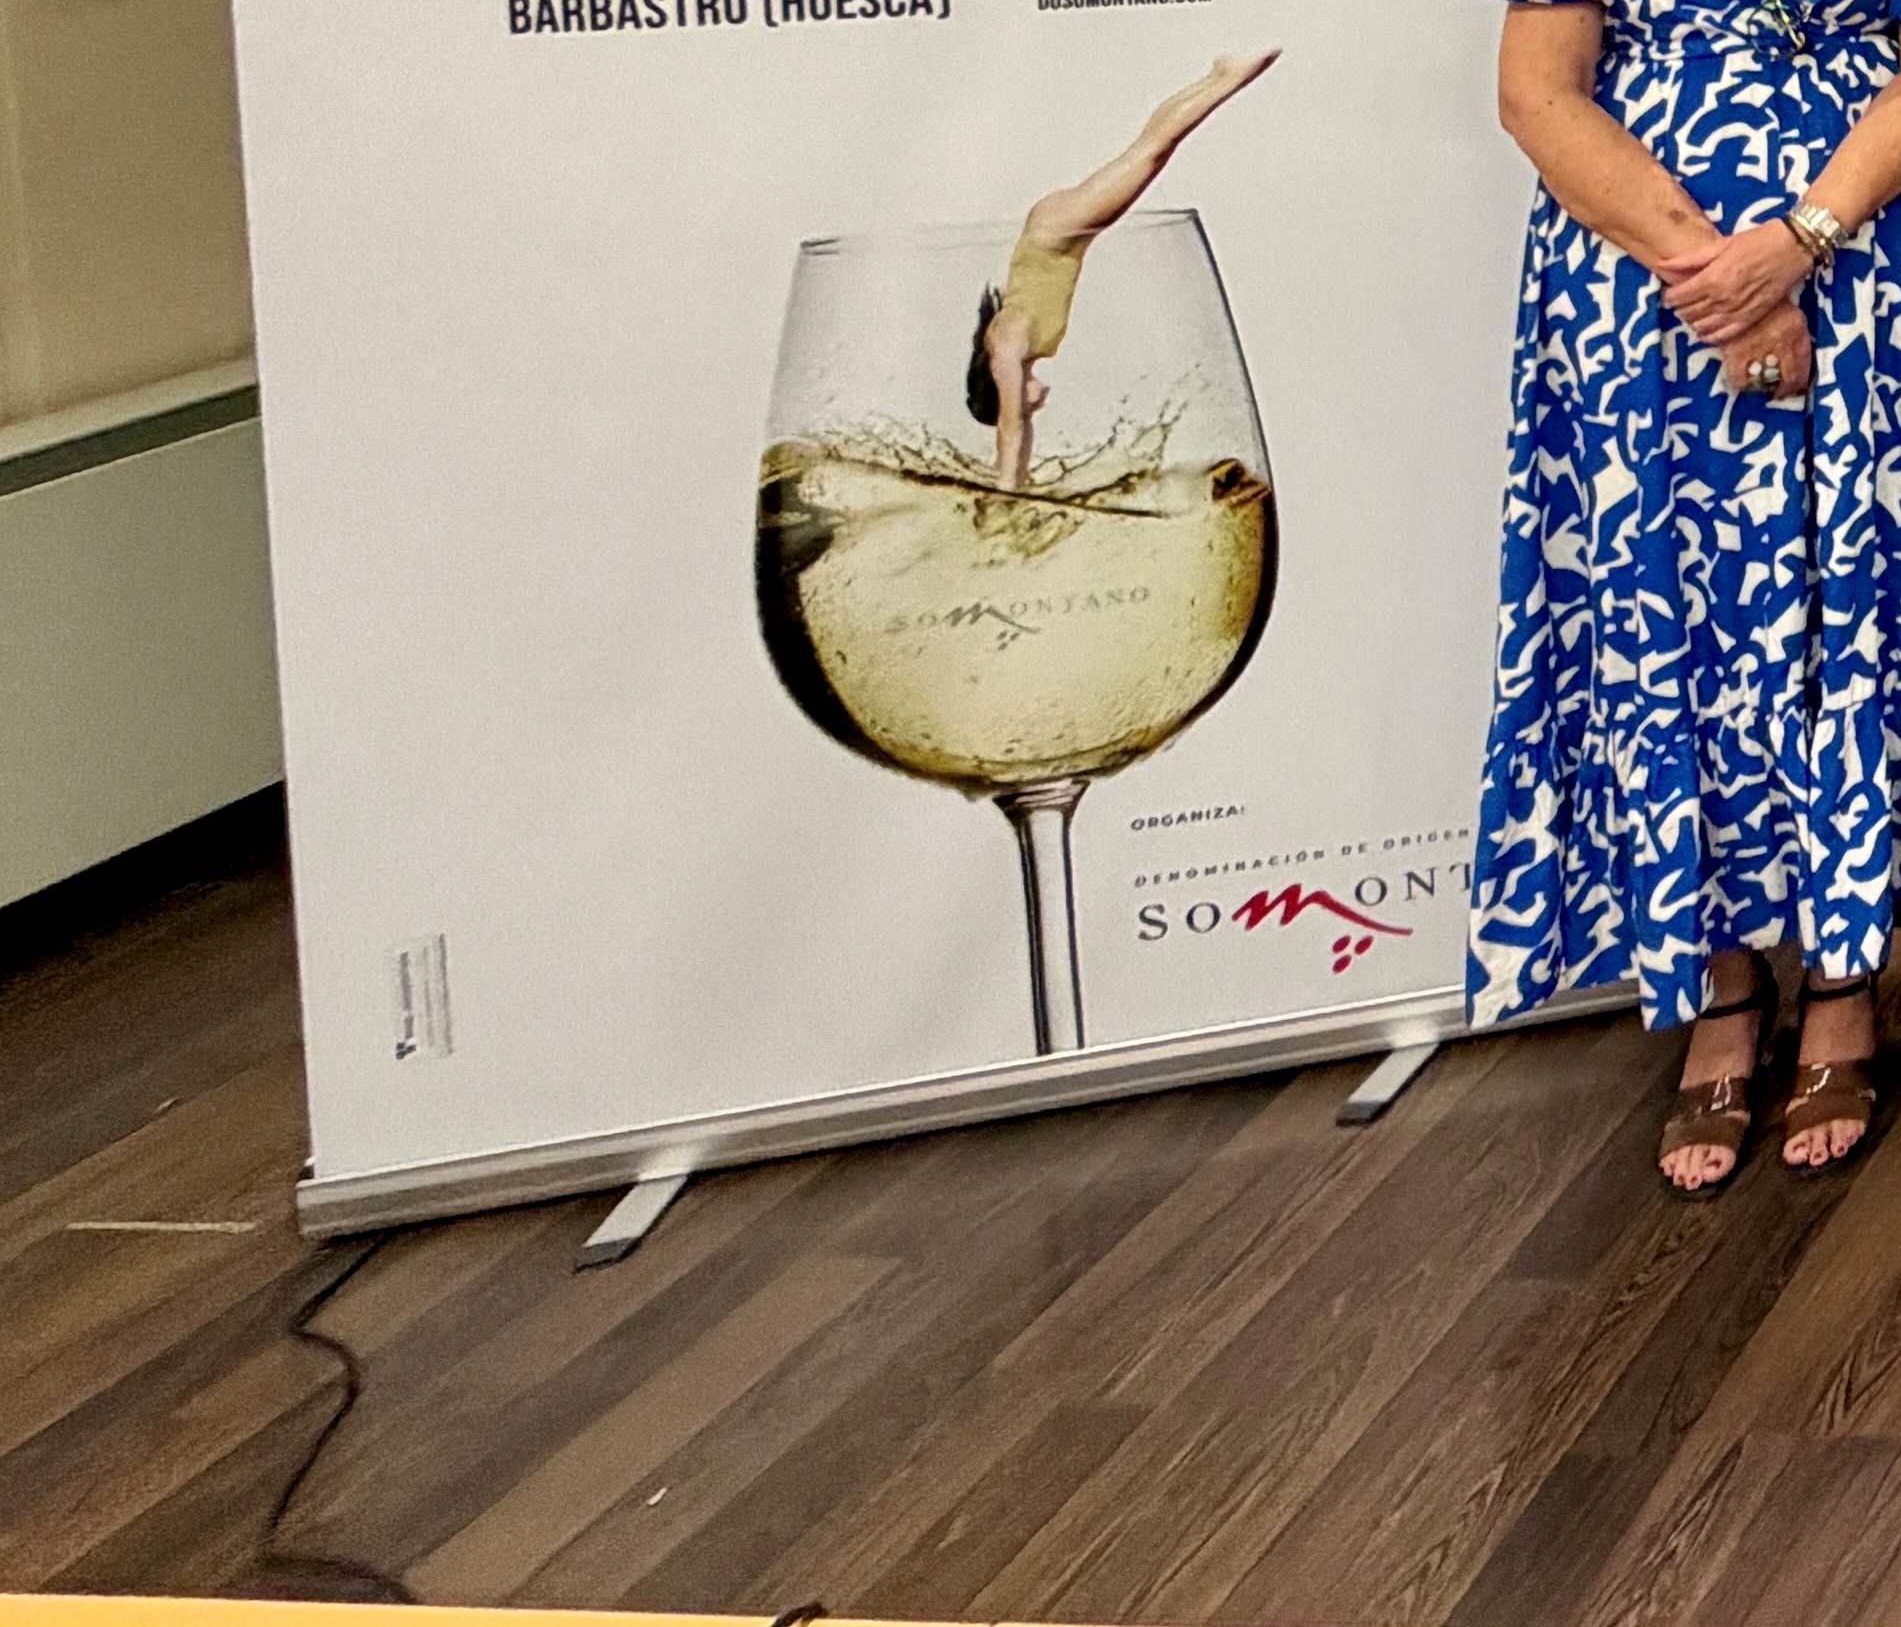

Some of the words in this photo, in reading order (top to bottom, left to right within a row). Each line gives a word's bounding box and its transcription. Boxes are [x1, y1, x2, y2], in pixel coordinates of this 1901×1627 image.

[1341, 842, 1367, 856] DE
[1383, 827, 1470, 851] ORIGEN
[1137, 862, 1471, 941] SOMONT
